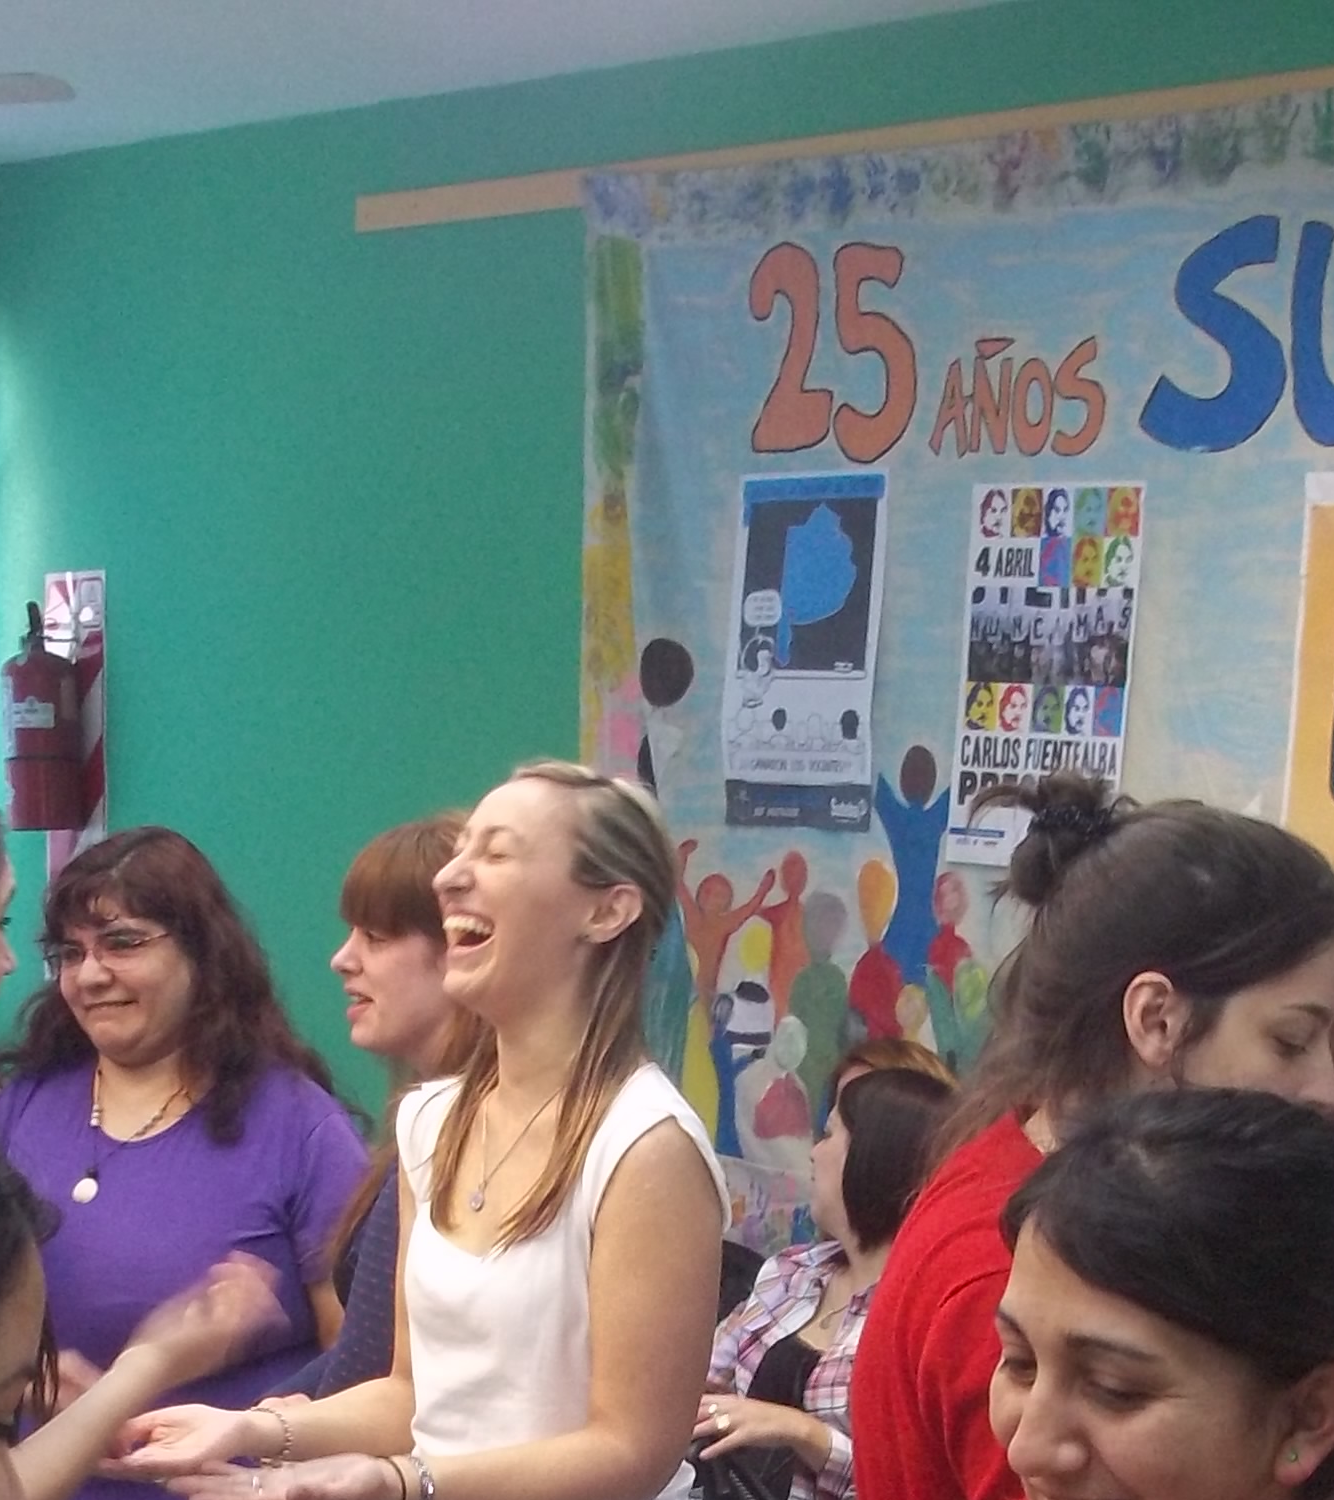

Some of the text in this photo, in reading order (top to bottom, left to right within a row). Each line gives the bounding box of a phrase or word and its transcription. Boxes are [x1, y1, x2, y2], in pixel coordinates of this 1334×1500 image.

[748, 240, 1107, 463] 25 AÑOS
[975, 546, 1035, 578] 4 ABRIL
[961, 735, 1117, 776] CARLOS FUENTEALBA
